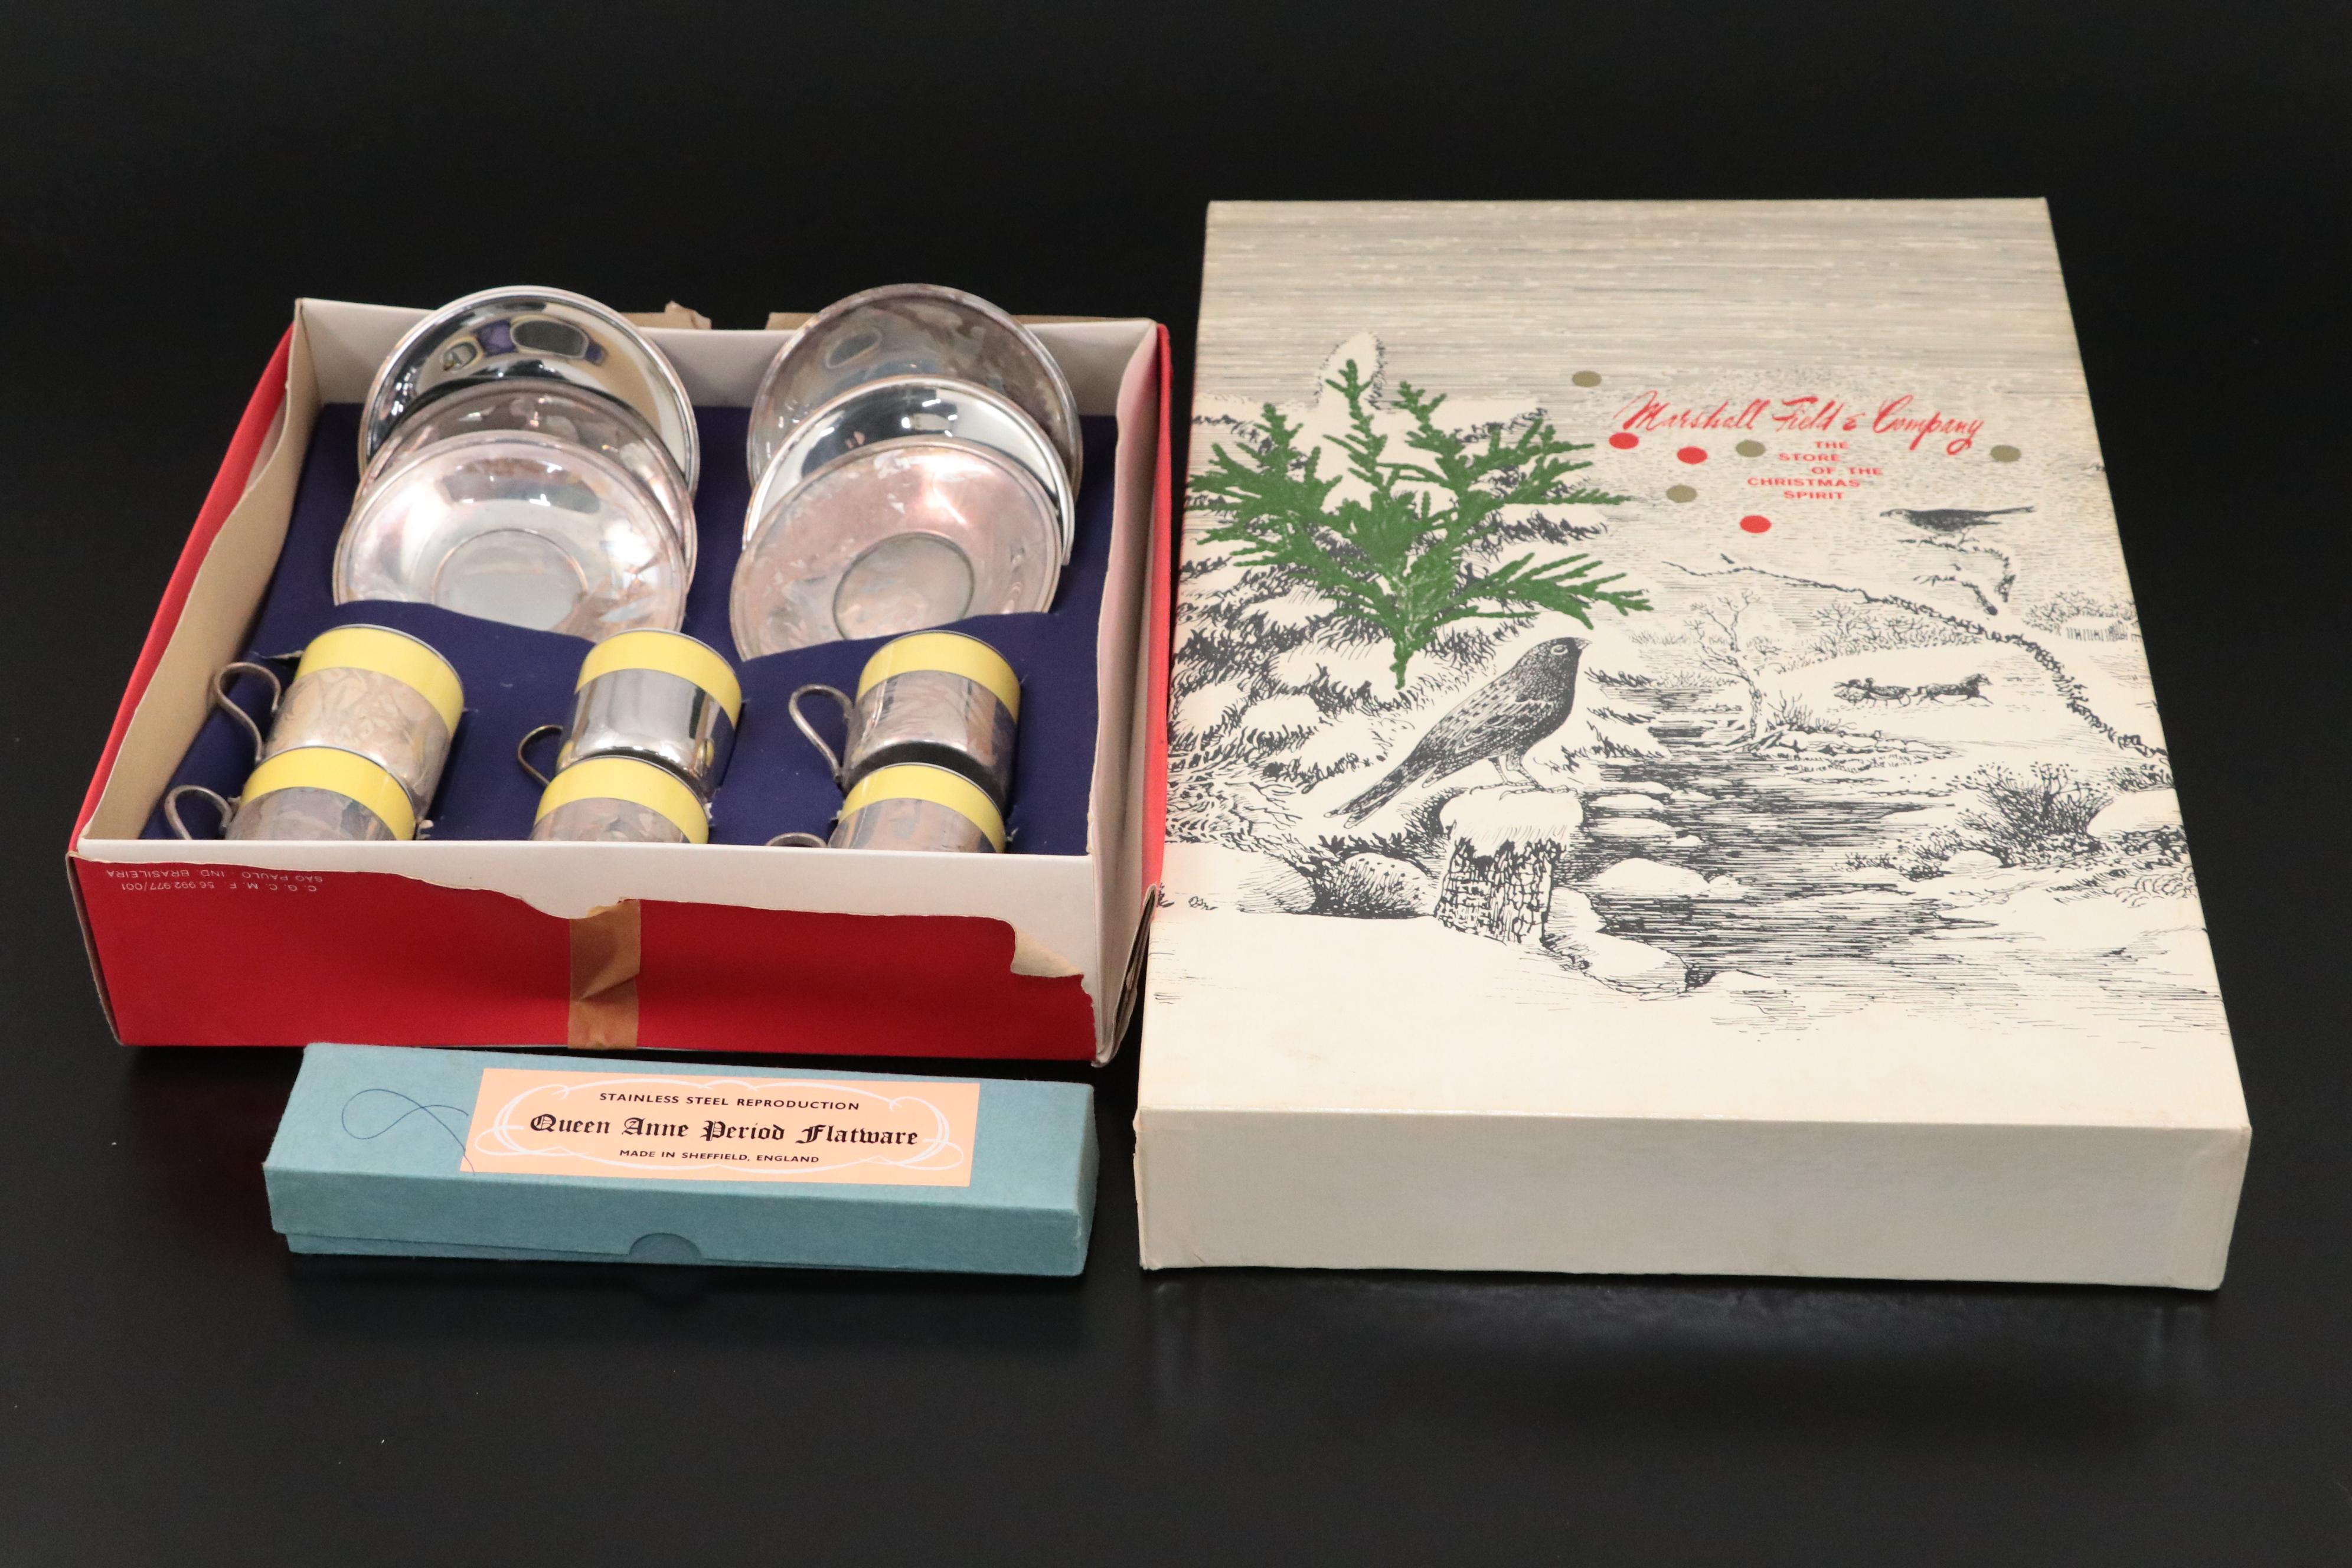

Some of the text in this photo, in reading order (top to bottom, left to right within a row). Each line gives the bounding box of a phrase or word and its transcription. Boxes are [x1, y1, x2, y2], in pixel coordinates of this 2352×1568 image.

[1612, 390, 1984, 456] Marshall Field & Company
[1815, 441, 1850, 450] THE
[1779, 453, 1841, 462] STORE
[1811, 466, 1882, 476] OF THE
[1747, 476, 1861, 488] CHRISTMAS
[1783, 490, 1843, 499] SPIRIT
[106, 869, 190, 878] BRASILEIRA
[241, 871, 289, 881] PAULO
[600, 1093, 859, 1110] STAINLESS STEEL REPRODUCTION
[530, 1113, 918, 1145] Queen Anne Period Flatware
[620, 1149, 655, 1158] MADE
[682, 1152, 750, 1162] SHEFFIELD,
[756, 1154, 819, 1163] ENGLAND
